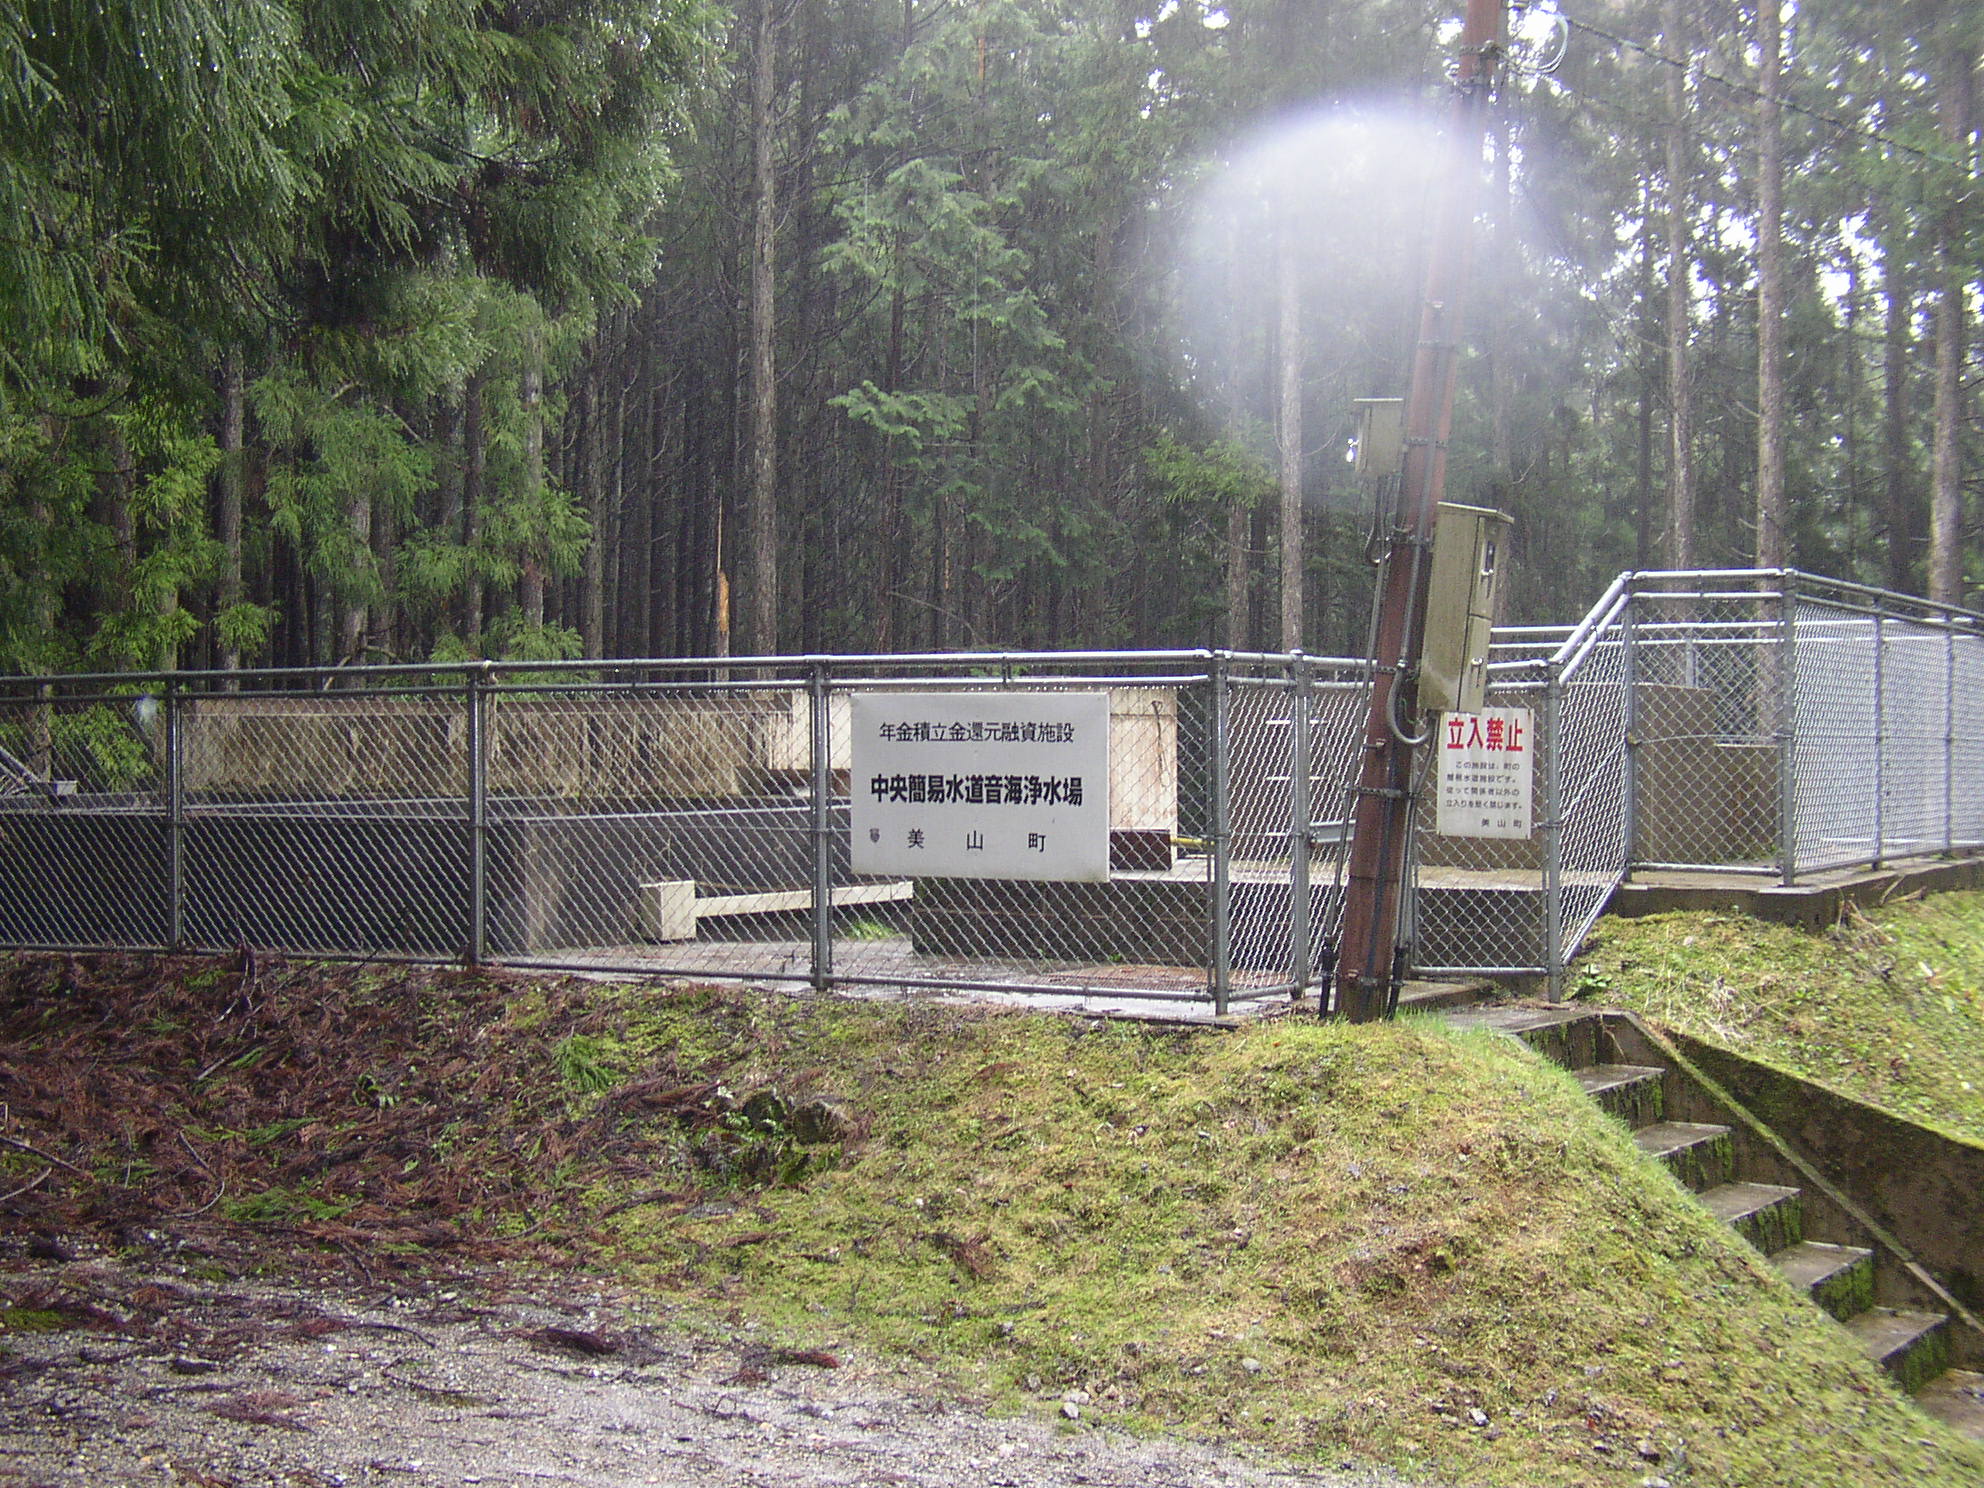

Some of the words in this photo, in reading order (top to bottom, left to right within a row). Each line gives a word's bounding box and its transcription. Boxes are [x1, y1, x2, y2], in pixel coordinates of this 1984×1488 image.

[879, 721, 1075, 743] 年金積立金還元融資施設
[1447, 717, 1524, 751] 立入禁止
[871, 774, 1083, 806] 中央簡易水道音海浄水場
